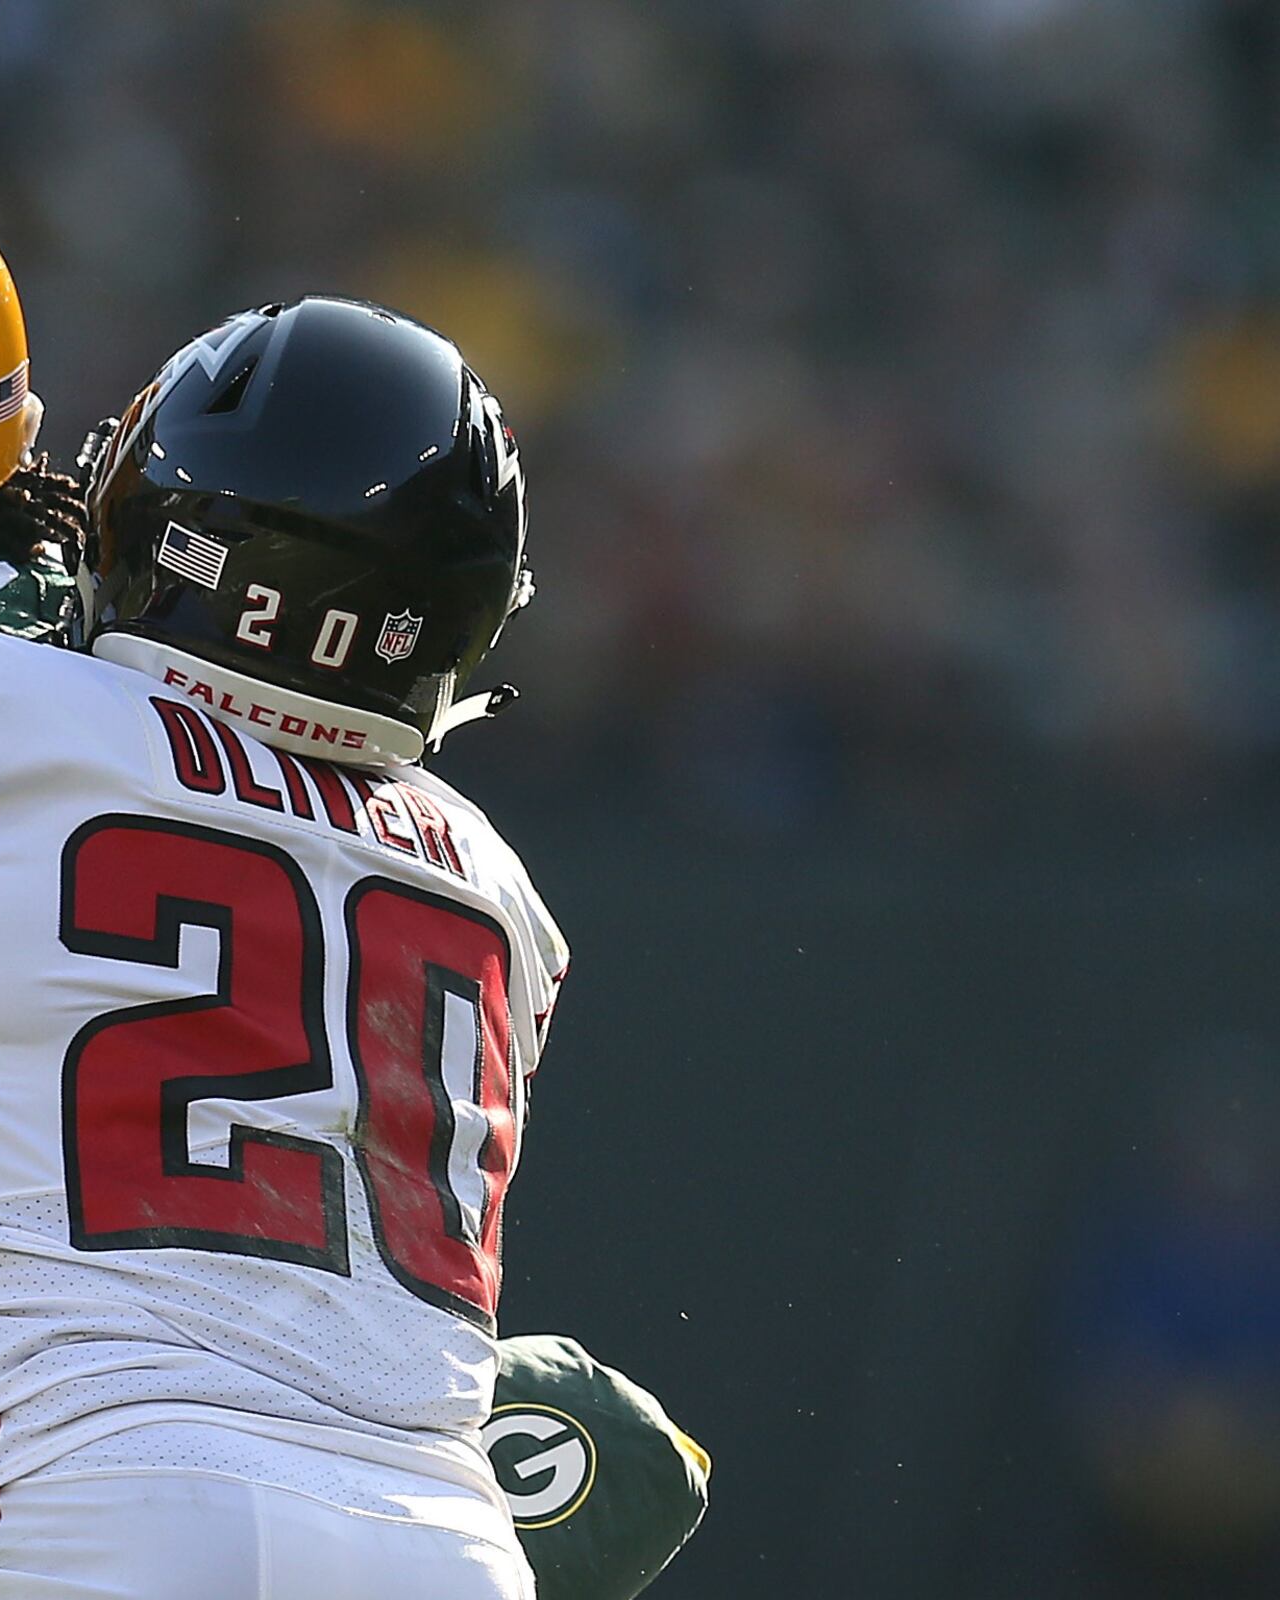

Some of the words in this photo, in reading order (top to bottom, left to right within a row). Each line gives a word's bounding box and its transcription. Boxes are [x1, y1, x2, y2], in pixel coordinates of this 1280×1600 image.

[163, 666, 367, 749] FALCONS
[381, 631, 412, 655] NFL
[149, 695, 467, 881] OLIVER
[58, 813, 515, 1340] 20
